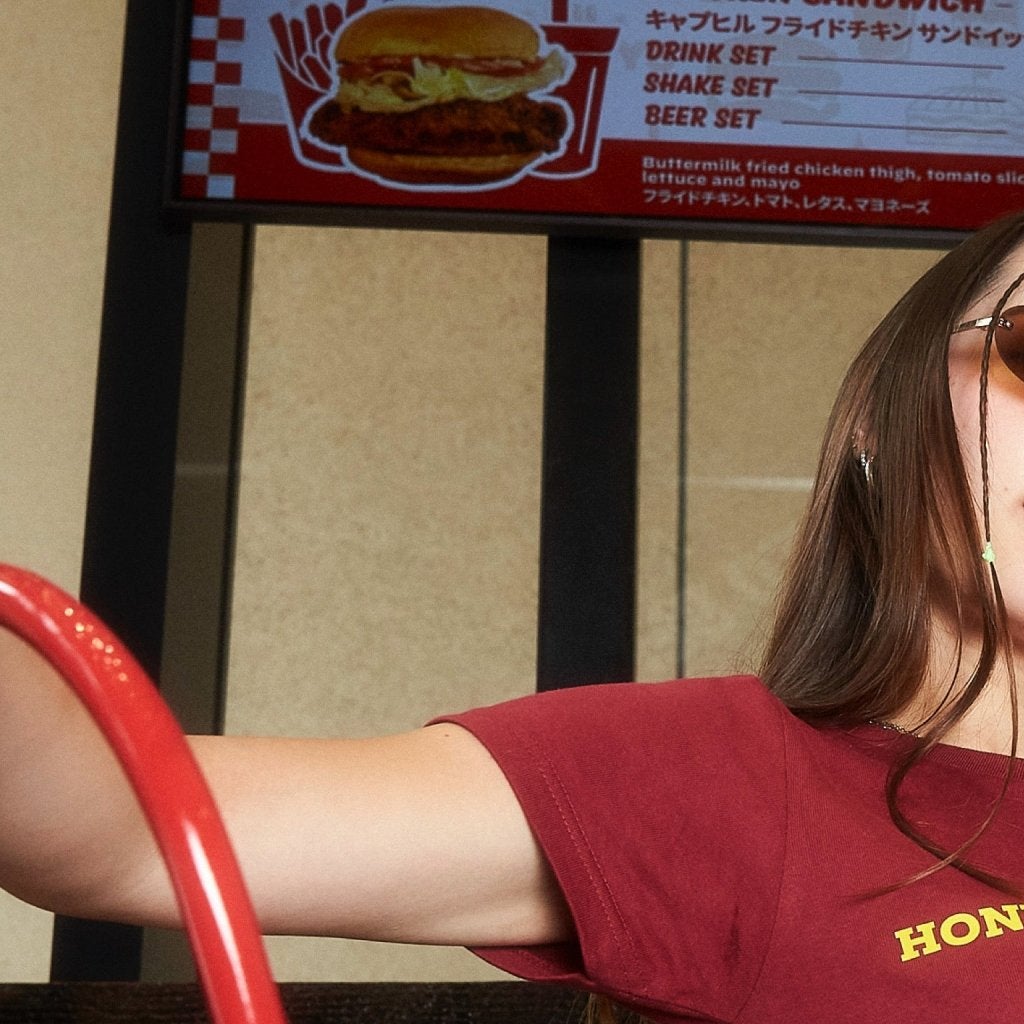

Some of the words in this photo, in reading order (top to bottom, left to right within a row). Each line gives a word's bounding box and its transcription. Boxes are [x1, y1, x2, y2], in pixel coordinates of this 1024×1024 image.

[761, 16, 912, 43] フライドチキン
[646, 40, 724, 64] DRINK
[729, 44, 776, 65] SET
[643, 72, 725, 95] SHAKE
[731, 76, 778, 97] SET
[644, 104, 708, 127] BEER
[714, 107, 761, 129] SET
[642, 156, 741, 172] Buttermilk
[746, 159, 790, 175] fried
[794, 163, 864, 178] chicken
[869, 166, 922, 183] thigh,
[926, 169, 992, 184] tomato
[642, 171, 706, 186] lettuce
[712, 174, 745, 187] and
[751, 177, 801, 192] mayo
